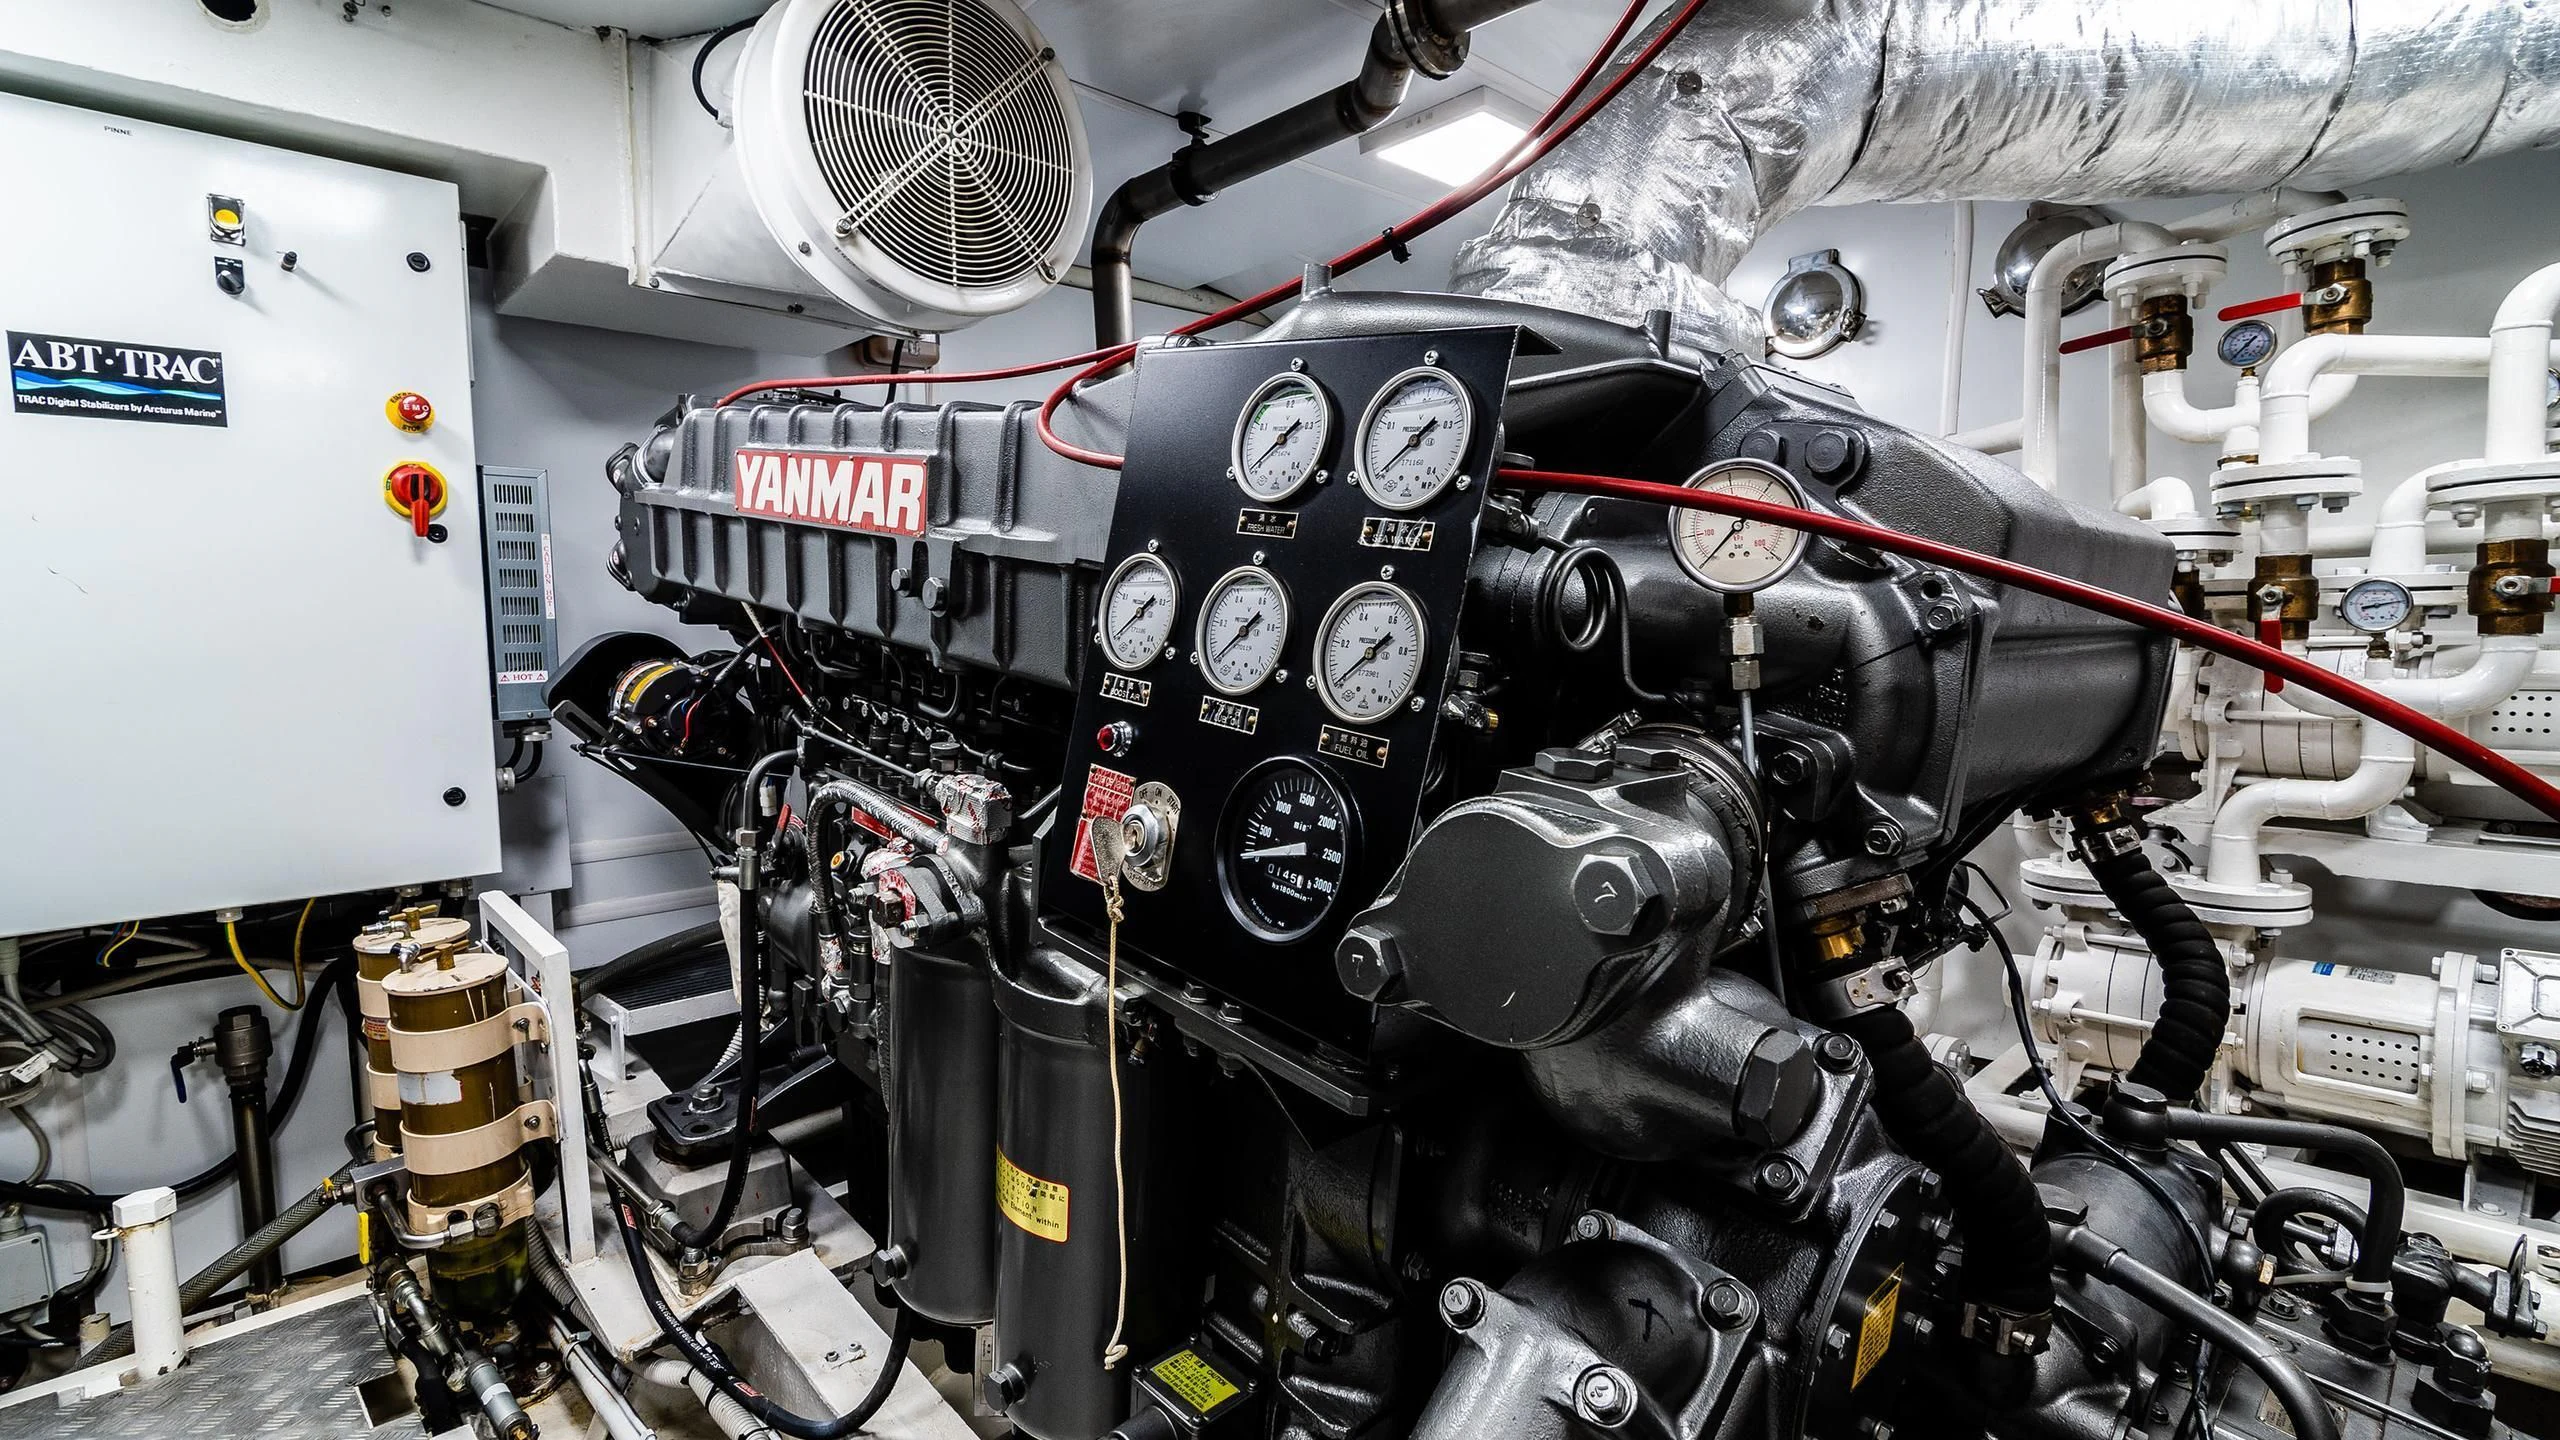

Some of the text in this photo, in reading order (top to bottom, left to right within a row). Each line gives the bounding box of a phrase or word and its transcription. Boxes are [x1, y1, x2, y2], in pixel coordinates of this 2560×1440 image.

[17, 394, 46, 405] TRAC
[47, 396, 79, 408] Digital
[80, 399, 129, 411] Stabilizers
[130, 404, 143, 413] by
[143, 404, 183, 416] Arcturus
[1387, 421, 1396, 430] 0.1
[1443, 421, 1453, 429] 0.3
[1427, 466, 1437, 475] 0.4
[737, 454, 924, 531] YANMAR
[1246, 523, 1285, 535] FRESH WATER
[1704, 528, 1715, 536] 100
[1372, 534, 1420, 547] SEA WATER
[1754, 539, 1766, 547] 600
[543, 545, 553, 607] CAUTION HOT
[1360, 612, 1369, 621] 0.4
[1388, 615, 1398, 624] 0.6
[1341, 639, 1350, 648] 0.2
[1398, 646, 1408, 656] 0.8
[1334, 743, 1369, 760] FUEL OIL
[1139, 787, 1180, 815] OFF ON START
[1299, 793, 1315, 807] 1500
[1275, 800, 1291, 815] 1000
[1318, 815, 1337, 830] 2000
[1259, 824, 1272, 838] 500
[1322, 848, 1341, 864] 2500
[1313, 877, 1333, 894] 3000
[1036, 1216, 1060, 1229] within
